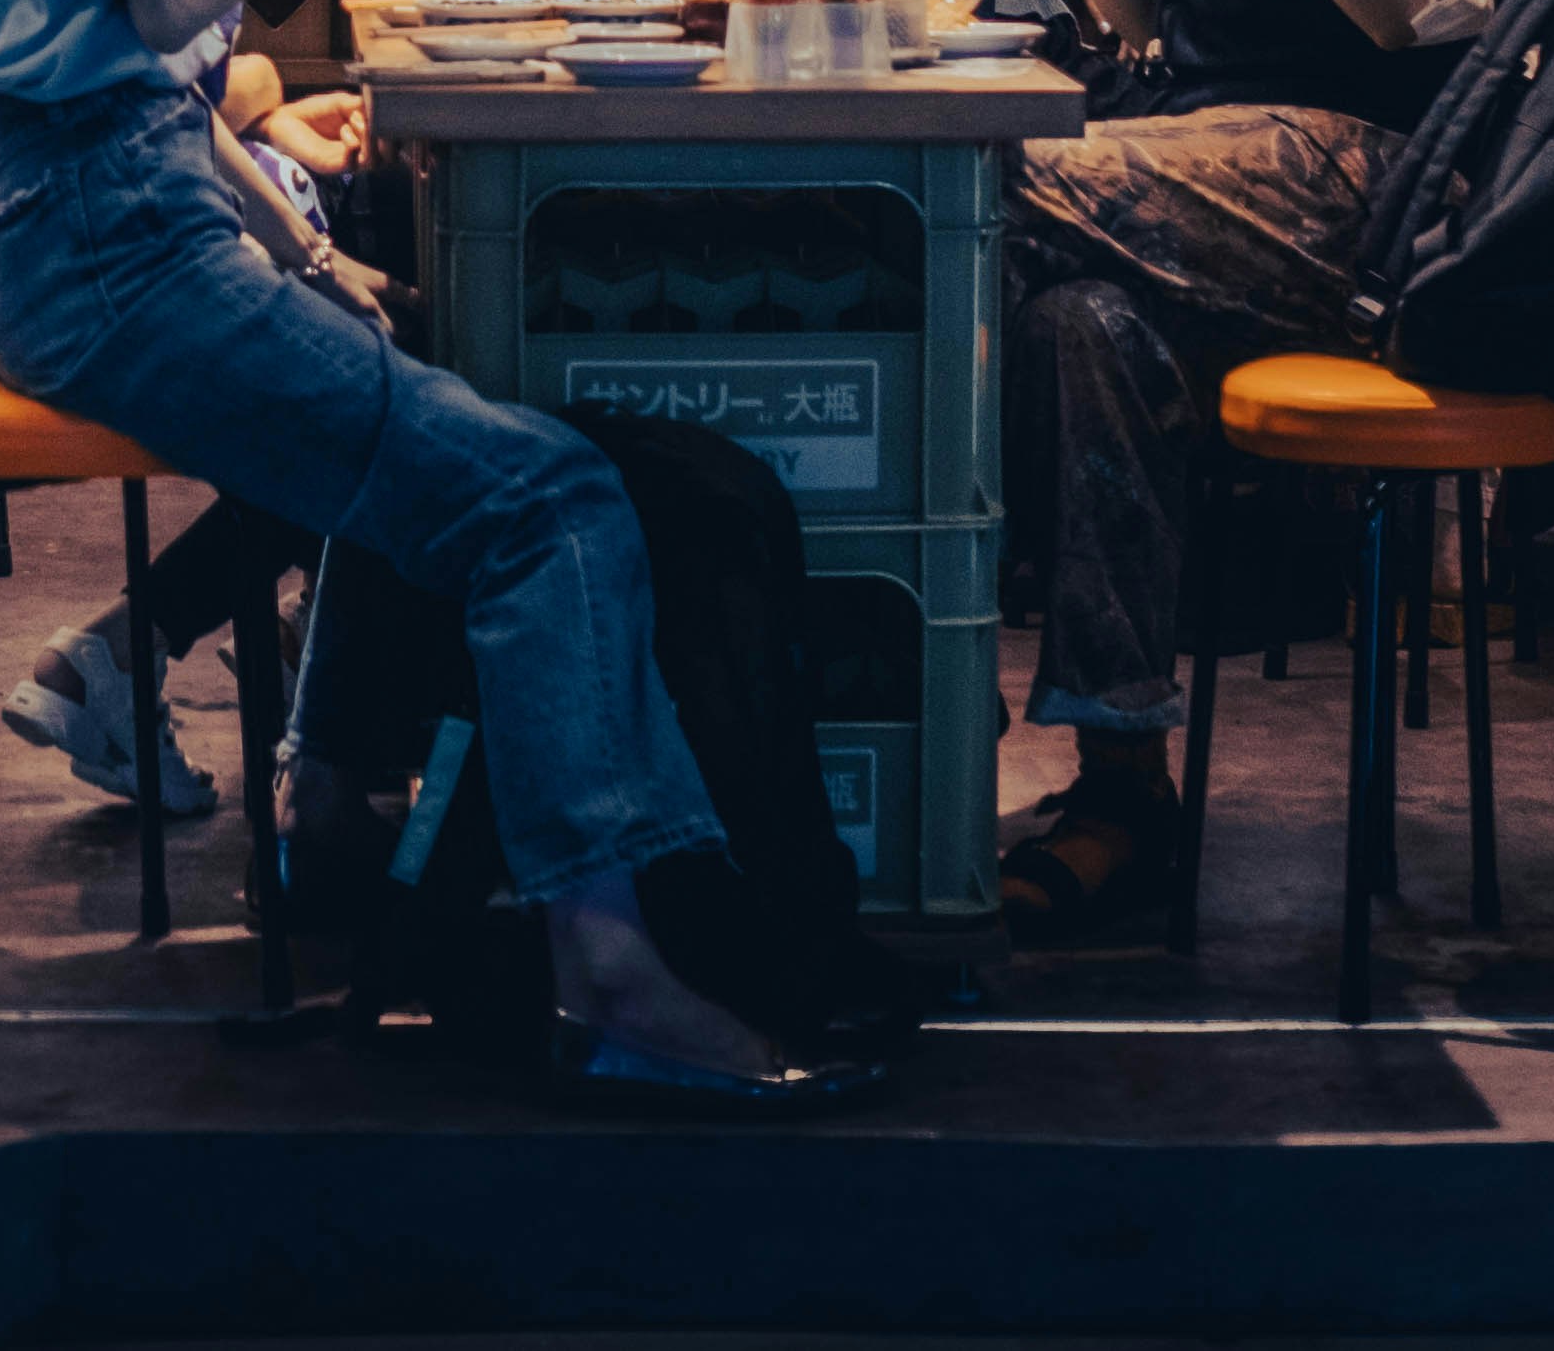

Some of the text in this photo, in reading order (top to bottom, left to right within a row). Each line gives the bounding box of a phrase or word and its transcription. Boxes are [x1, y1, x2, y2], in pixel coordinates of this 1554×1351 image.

[583, 382, 765, 422] サントリー
